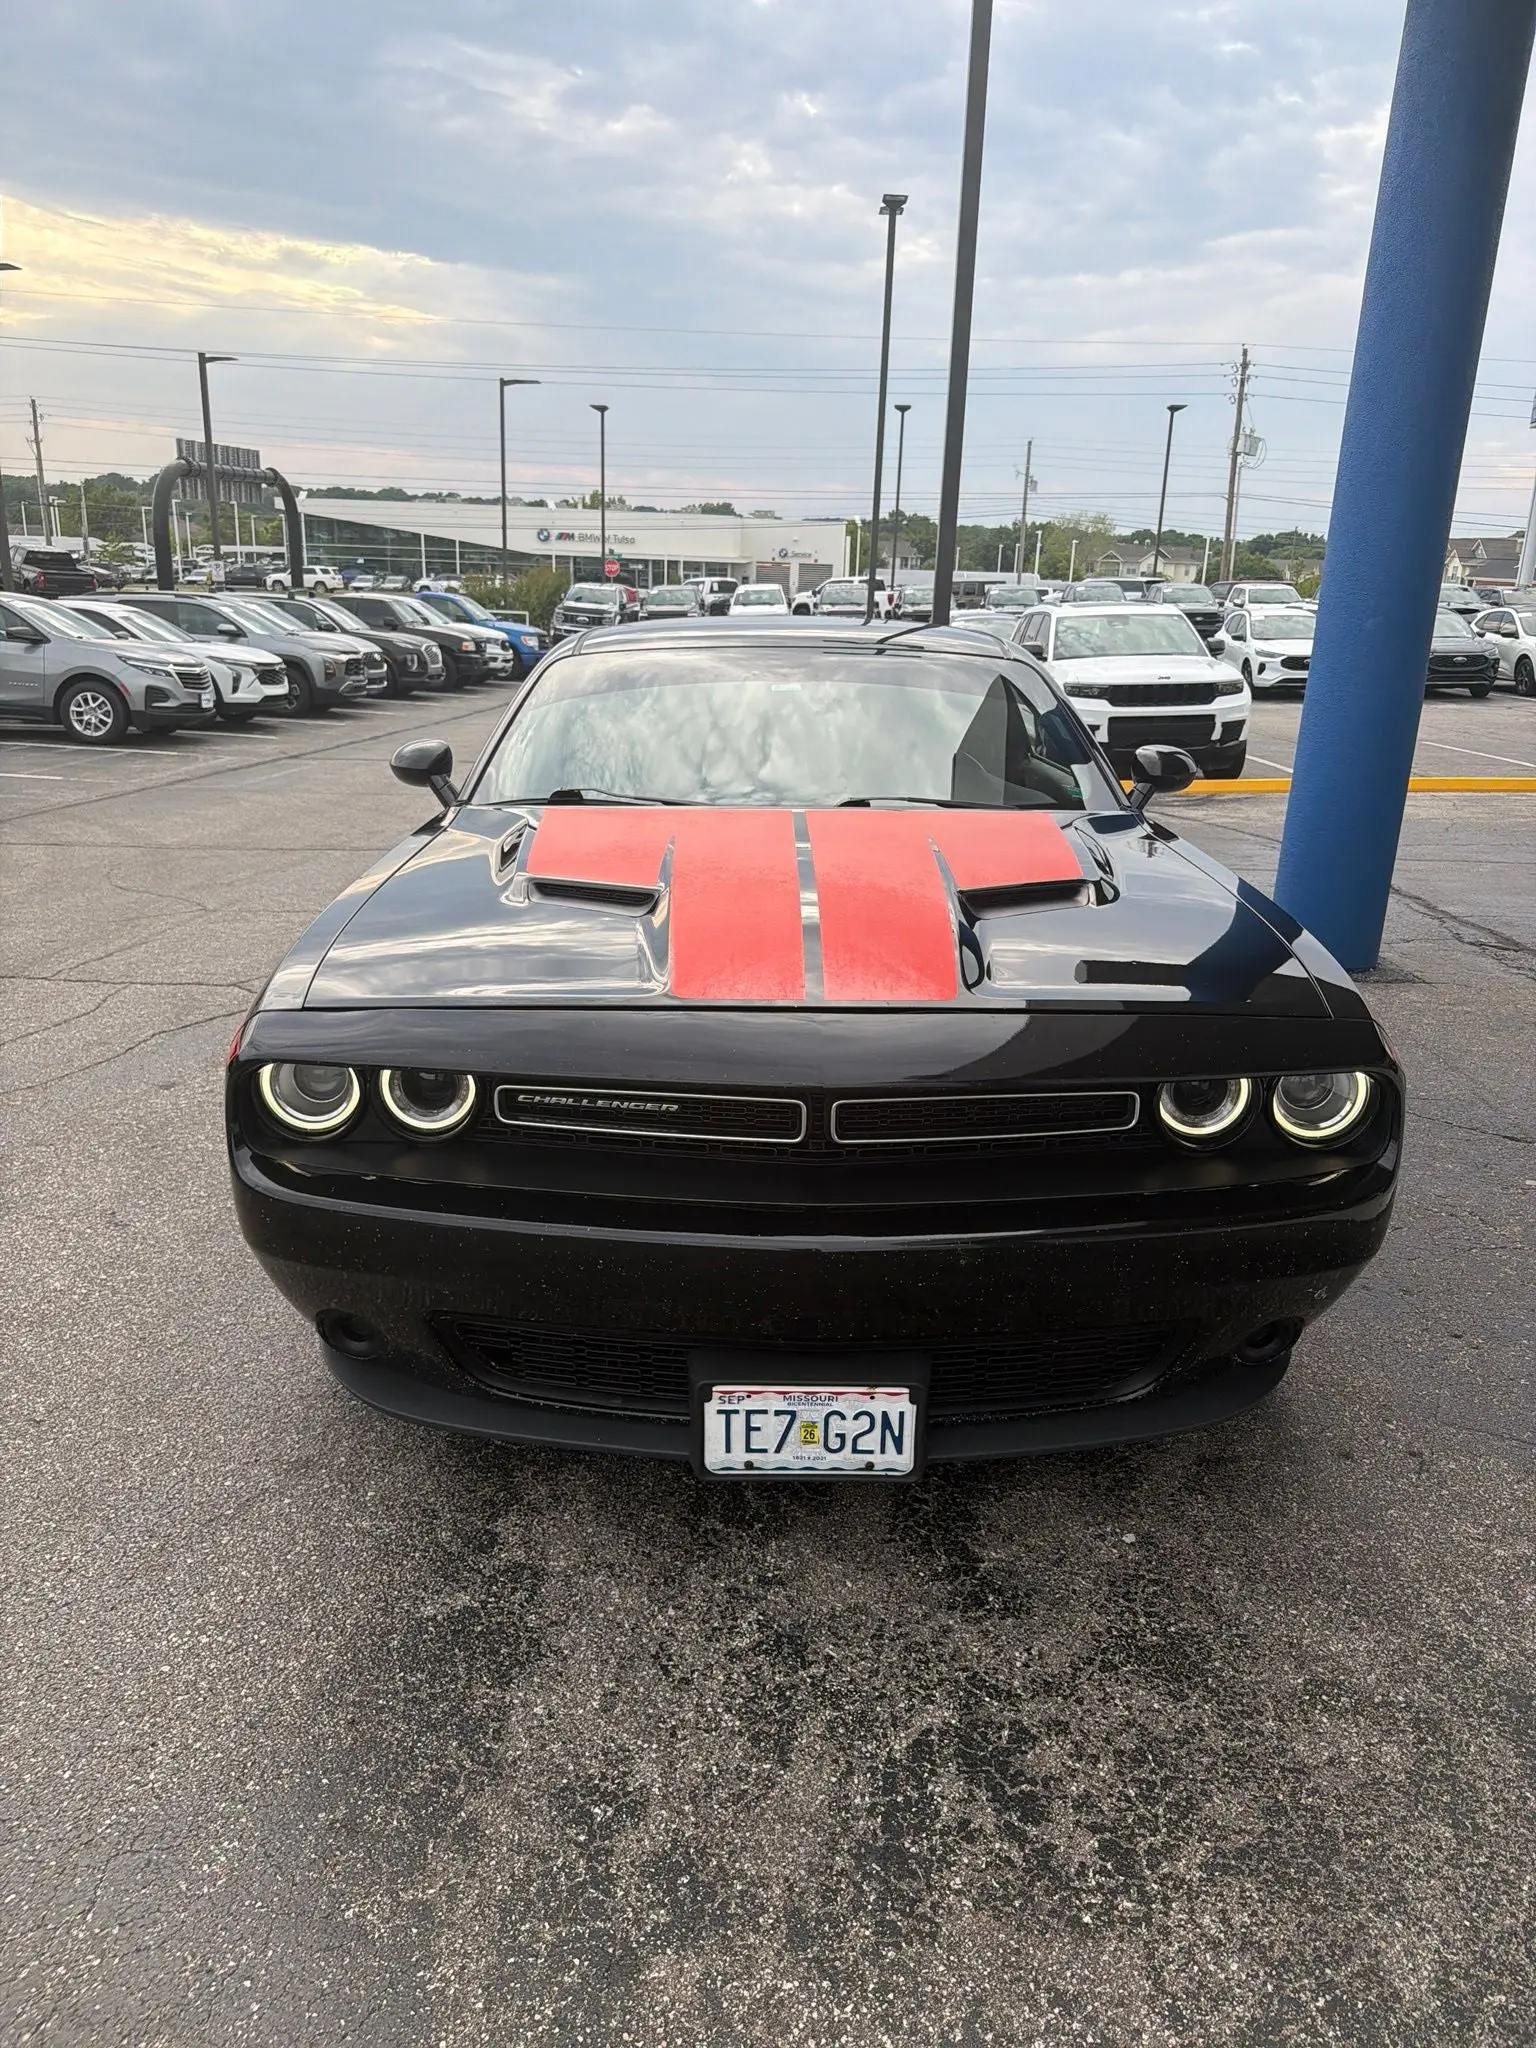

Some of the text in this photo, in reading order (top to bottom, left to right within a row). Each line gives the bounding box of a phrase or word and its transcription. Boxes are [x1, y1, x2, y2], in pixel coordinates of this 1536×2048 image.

[578, 532, 602, 543] BMW
[612, 534, 636, 545] Tulsa
[517, 1094, 679, 1112] CHALLENGER
[718, 1395, 745, 1405] SEP
[782, 1395, 839, 1403] MISSOURI
[716, 1409, 905, 1455] TE7 G2N
[803, 1429, 815, 1440] 26
